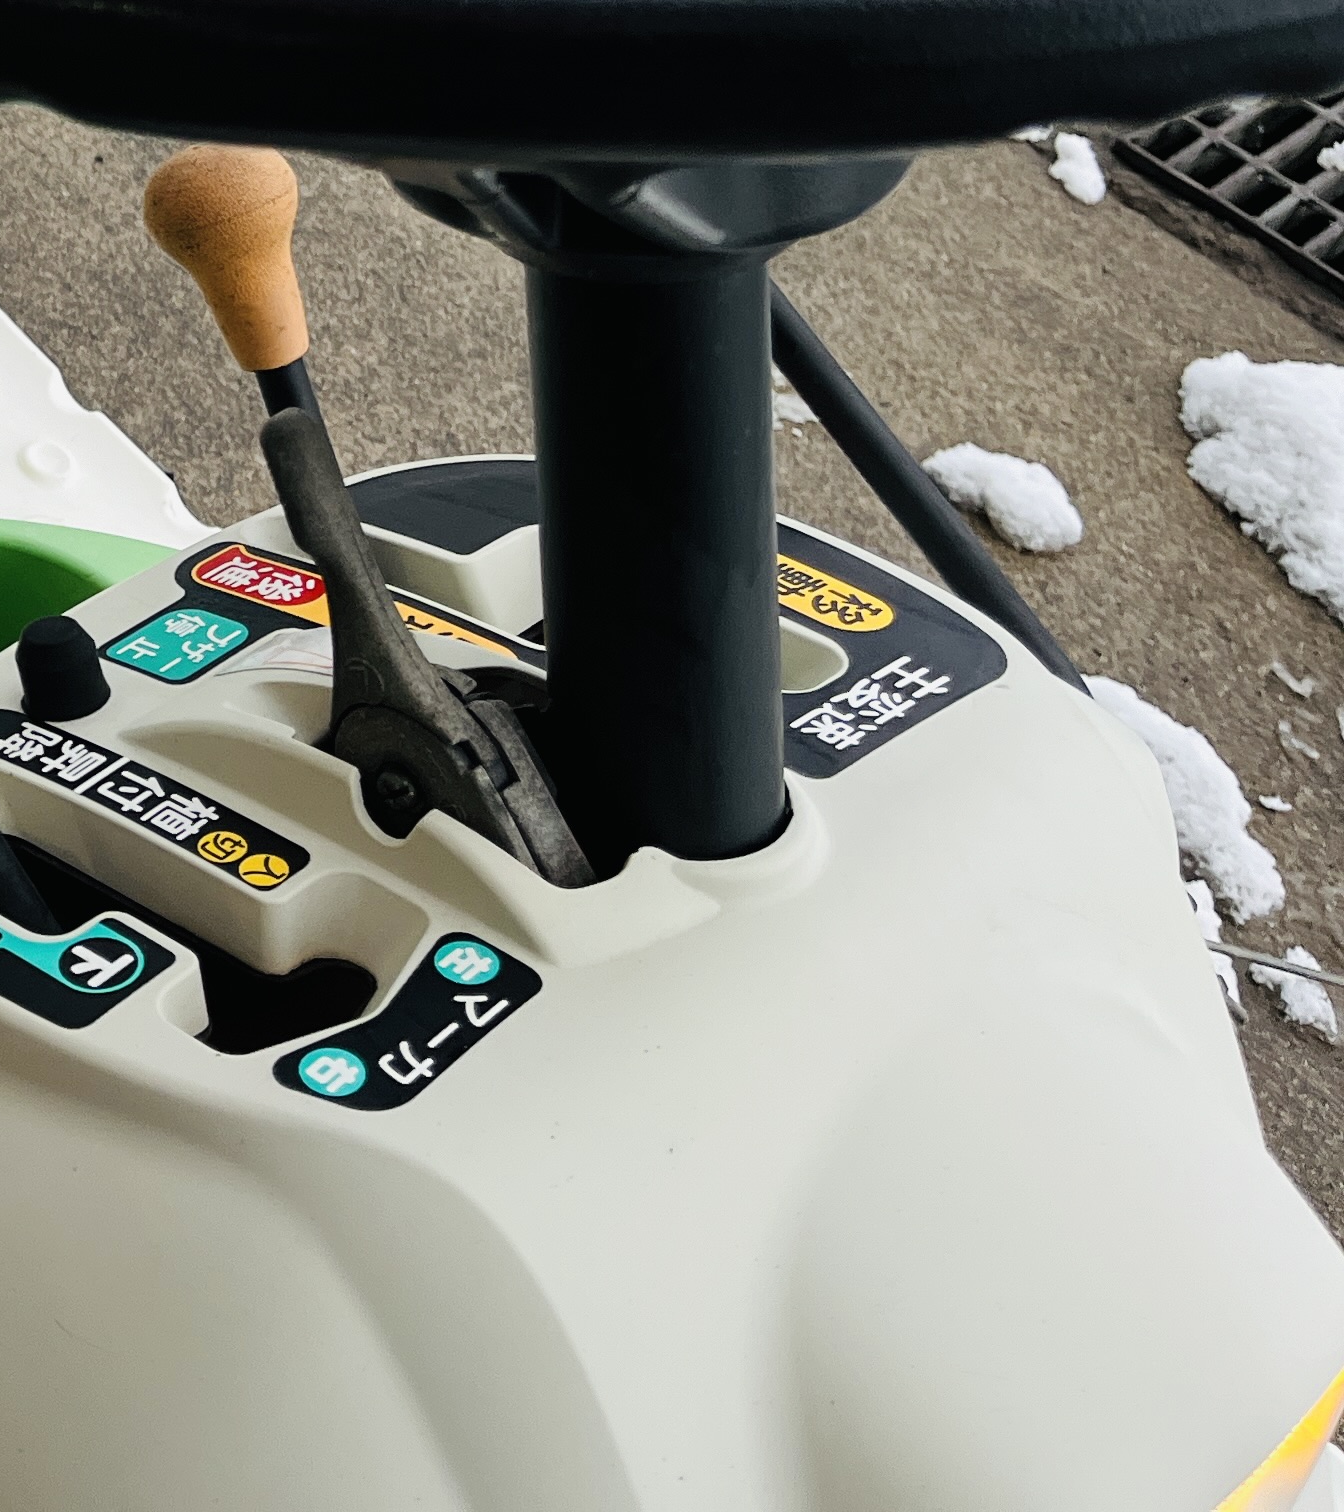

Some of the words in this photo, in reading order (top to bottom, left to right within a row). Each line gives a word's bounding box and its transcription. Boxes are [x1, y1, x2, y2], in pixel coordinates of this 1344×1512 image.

[204, 555, 316, 603] 後進
[789, 655, 951, 751] 主変速
[202, 833, 247, 861] 切
[70, 944, 135, 988] 下
[437, 947, 496, 981] 左
[378, 994, 510, 1085] マーカ
[305, 1055, 359, 1093] 右
